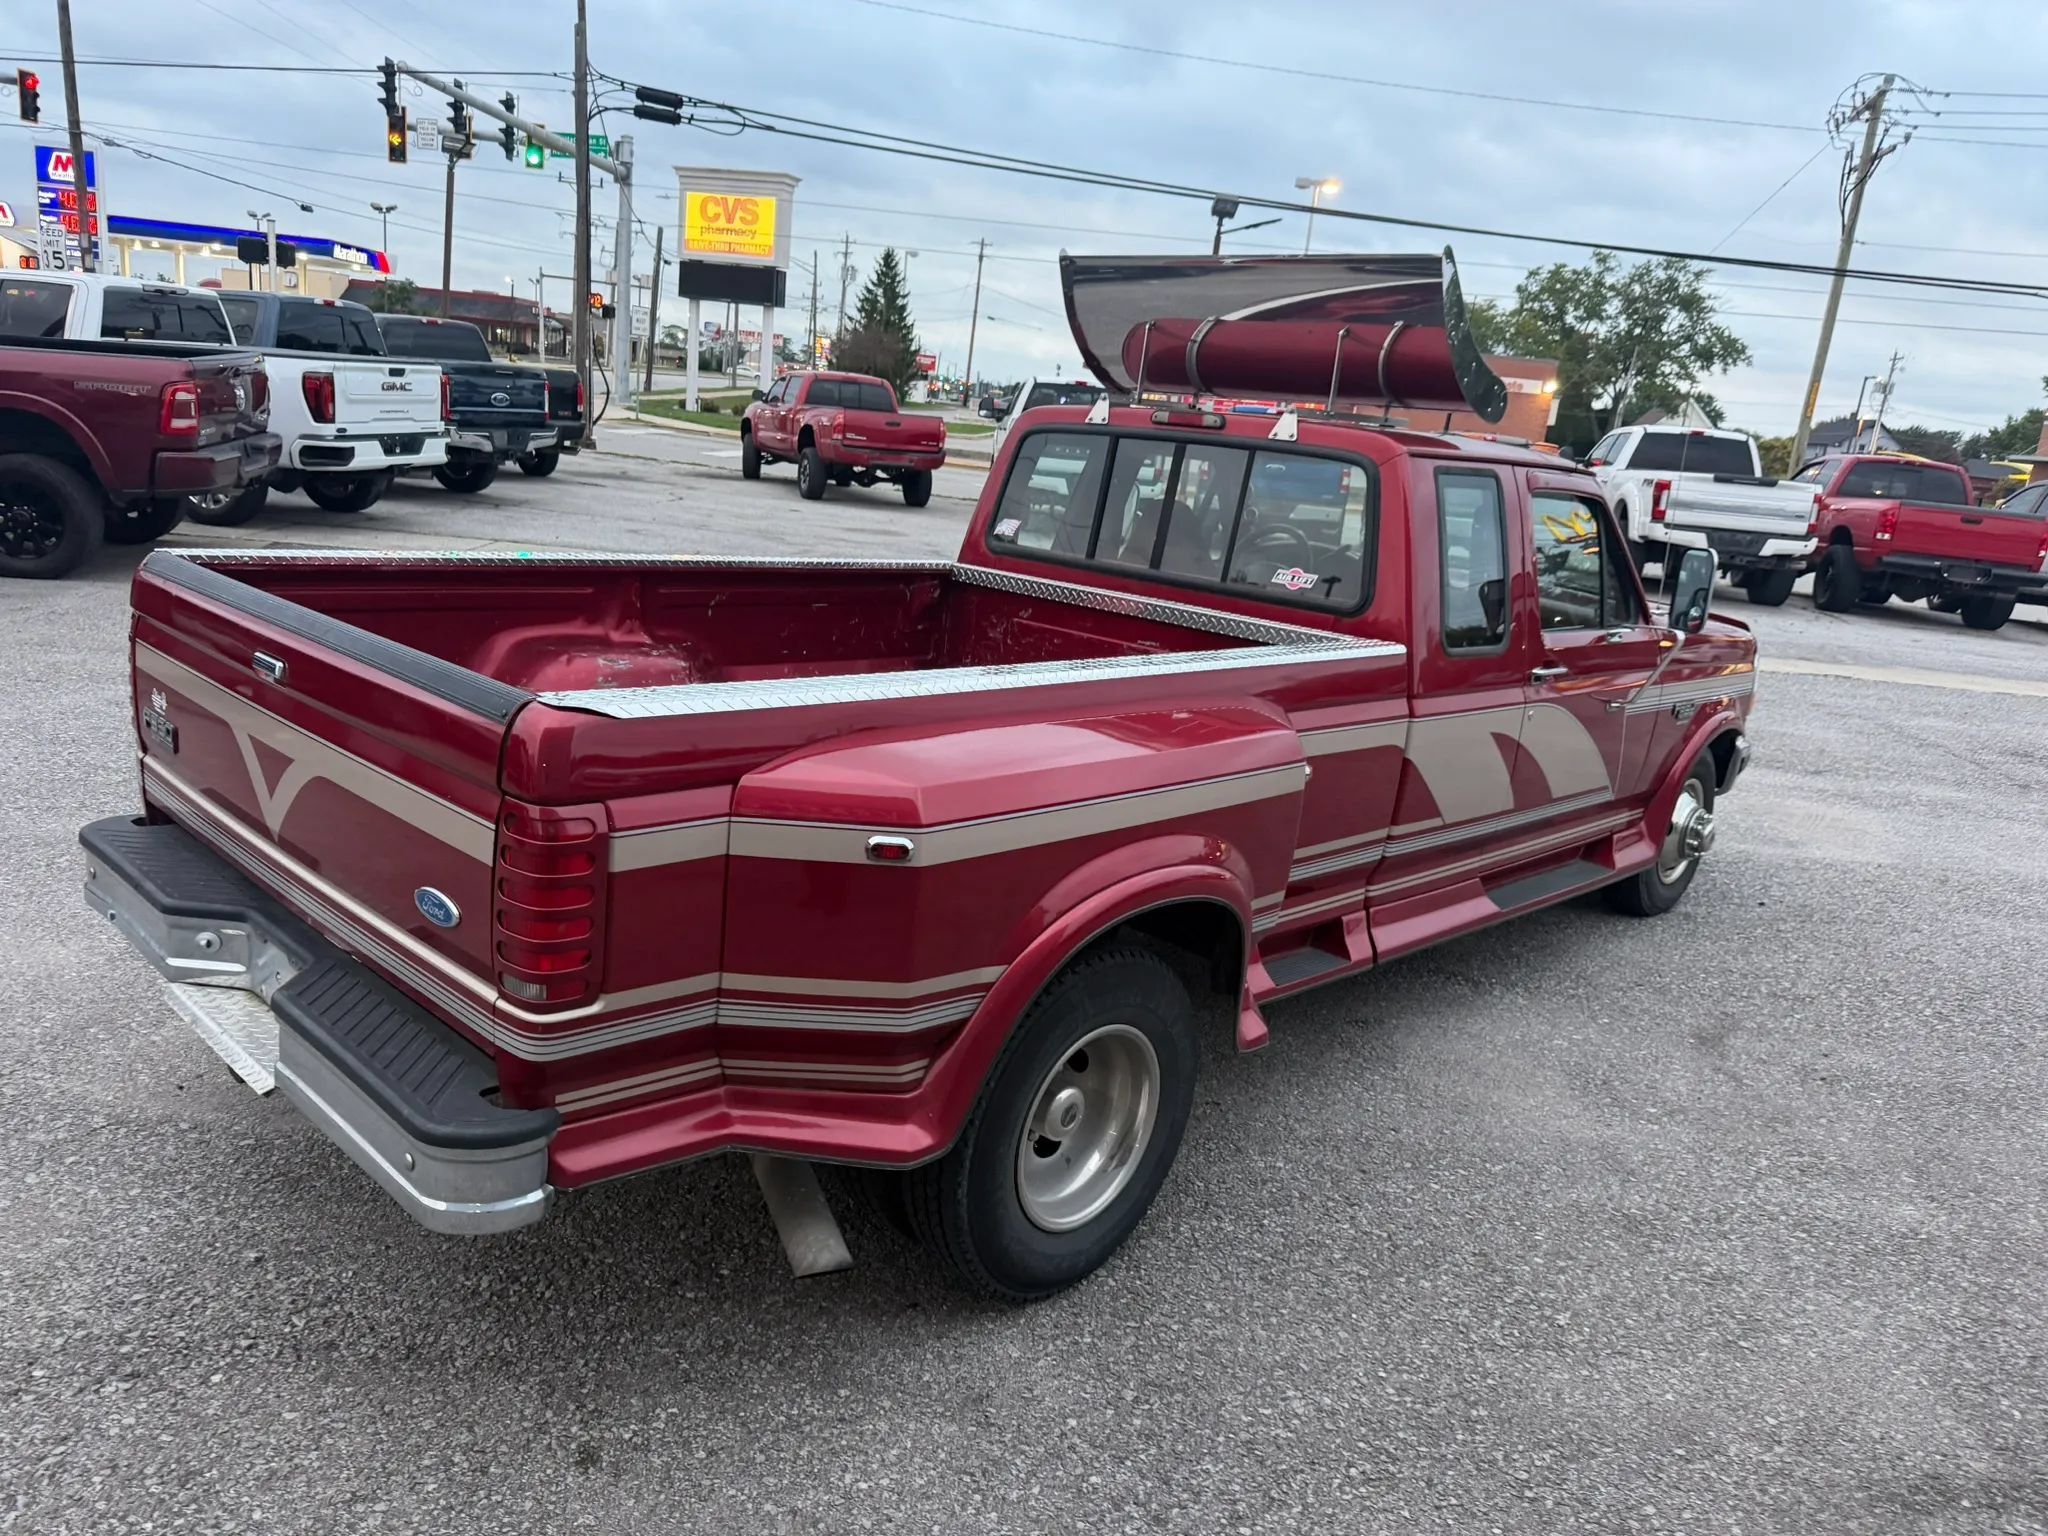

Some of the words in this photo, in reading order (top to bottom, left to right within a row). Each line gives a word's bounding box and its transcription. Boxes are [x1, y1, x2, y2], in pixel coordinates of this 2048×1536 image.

[700, 195, 759, 226] CVS
[700, 224, 757, 240] pharmacy
[333, 243, 368, 265] Marathon
[730, 242, 770, 256] PHARMACY
[381, 382, 413, 392] GMC
[421, 894, 446, 920] Ford
